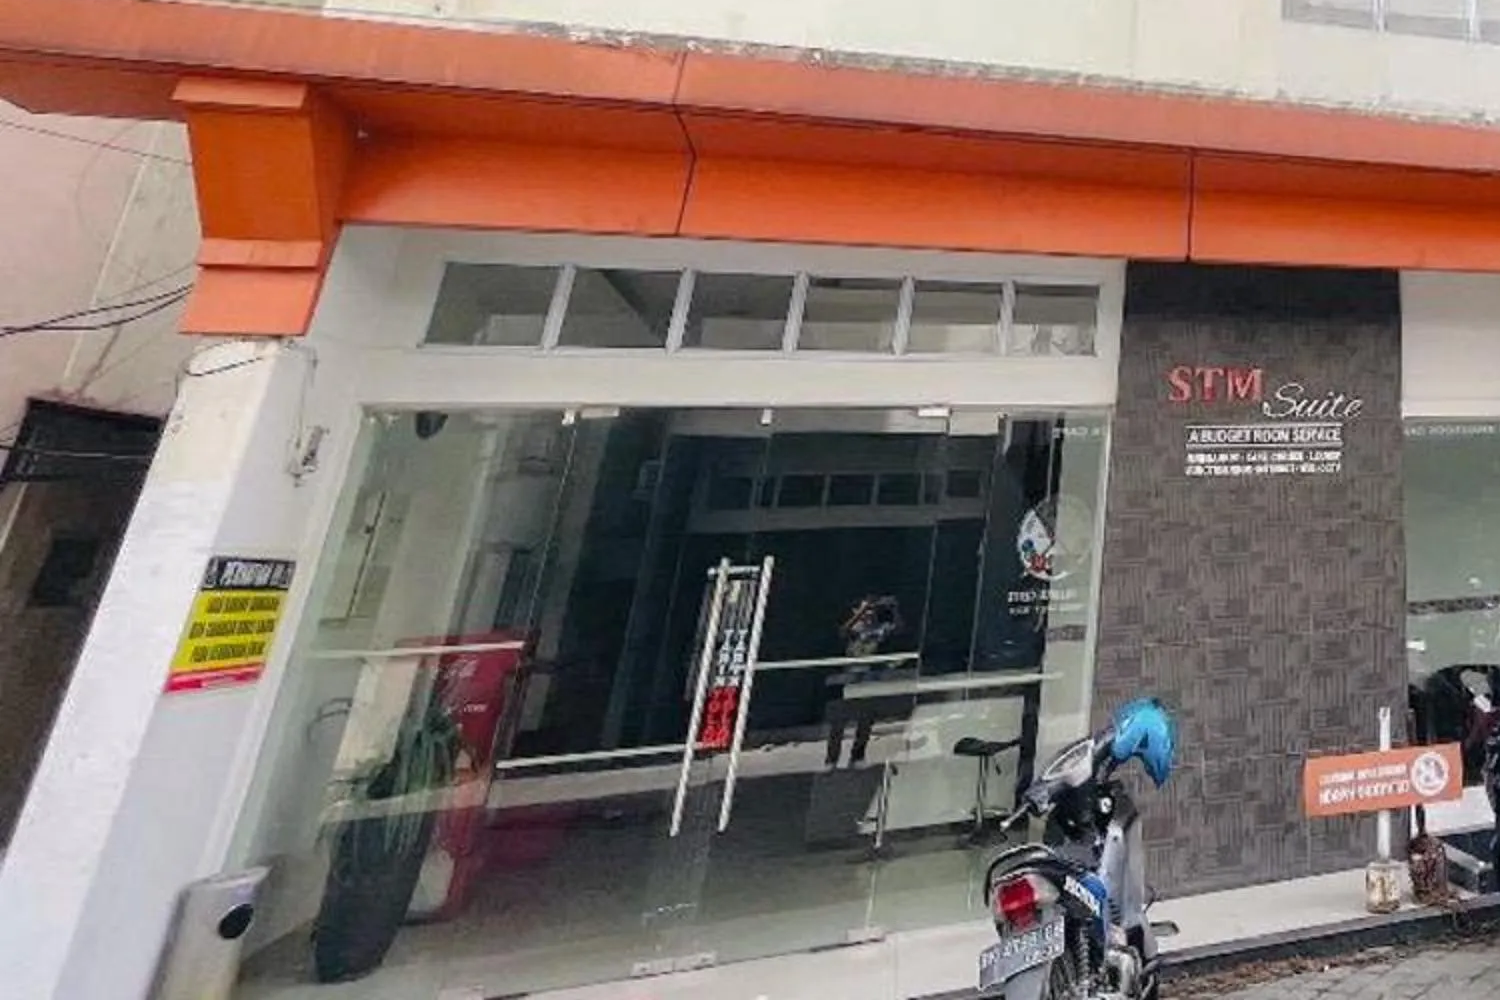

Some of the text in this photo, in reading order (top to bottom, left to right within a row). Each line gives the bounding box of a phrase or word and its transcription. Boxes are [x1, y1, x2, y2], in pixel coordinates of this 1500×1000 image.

[1167, 366, 1363, 418] STM Suite
[1189, 430, 1198, 442] A
[1200, 429, 1250, 443] BUDGET
[1292, 427, 1341, 441] SERVICE
